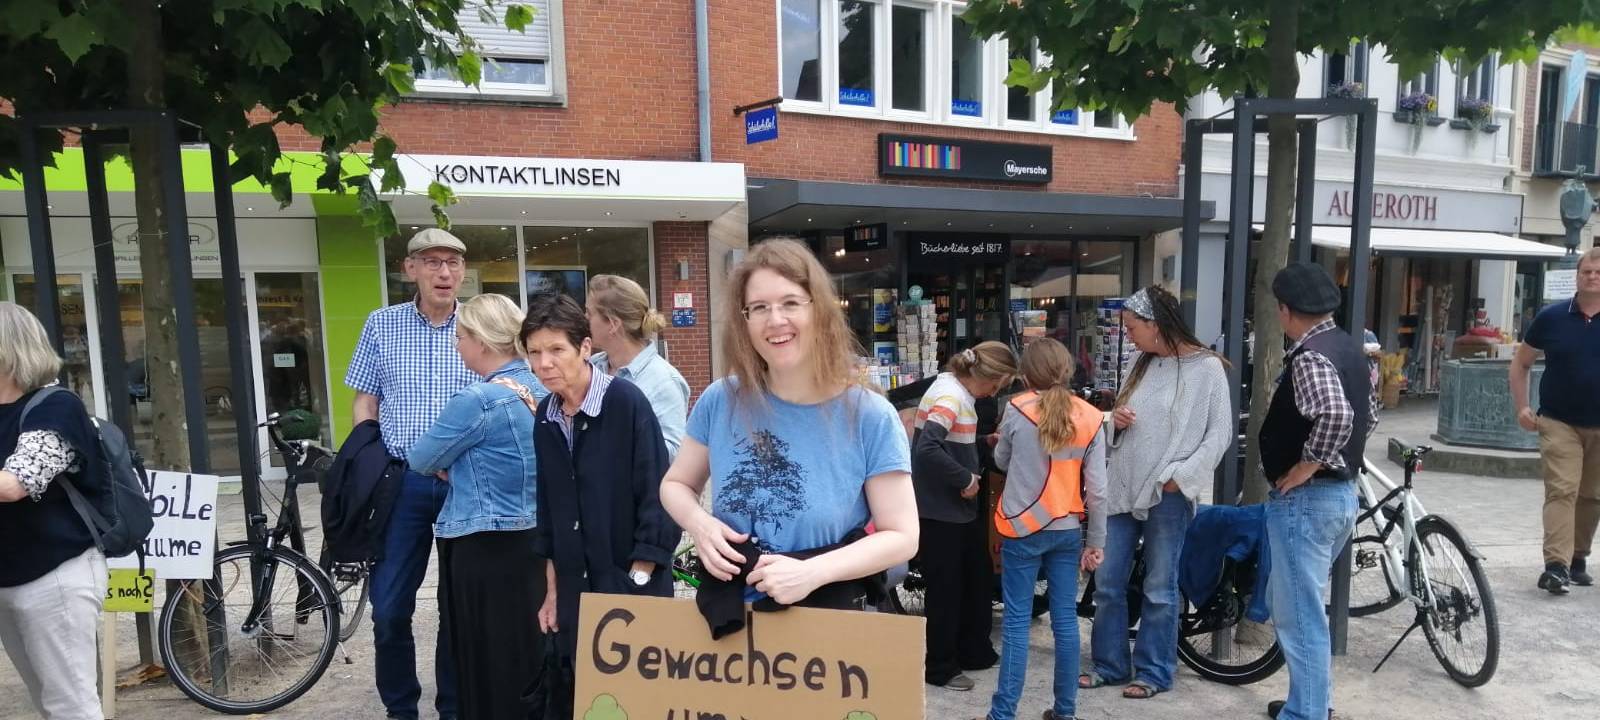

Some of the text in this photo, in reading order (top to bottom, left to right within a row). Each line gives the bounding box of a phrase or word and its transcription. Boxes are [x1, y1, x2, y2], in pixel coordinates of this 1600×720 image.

[435, 164, 621, 186] KONTAKTLINSEN
[1006, 163, 1048, 175] Mayersche
[1327, 190, 1438, 221] AUEROTH
[920, 242, 969, 255] Bücherliebe
[972, 242, 984, 255] seit
[592, 608, 869, 699] Gewachsen
